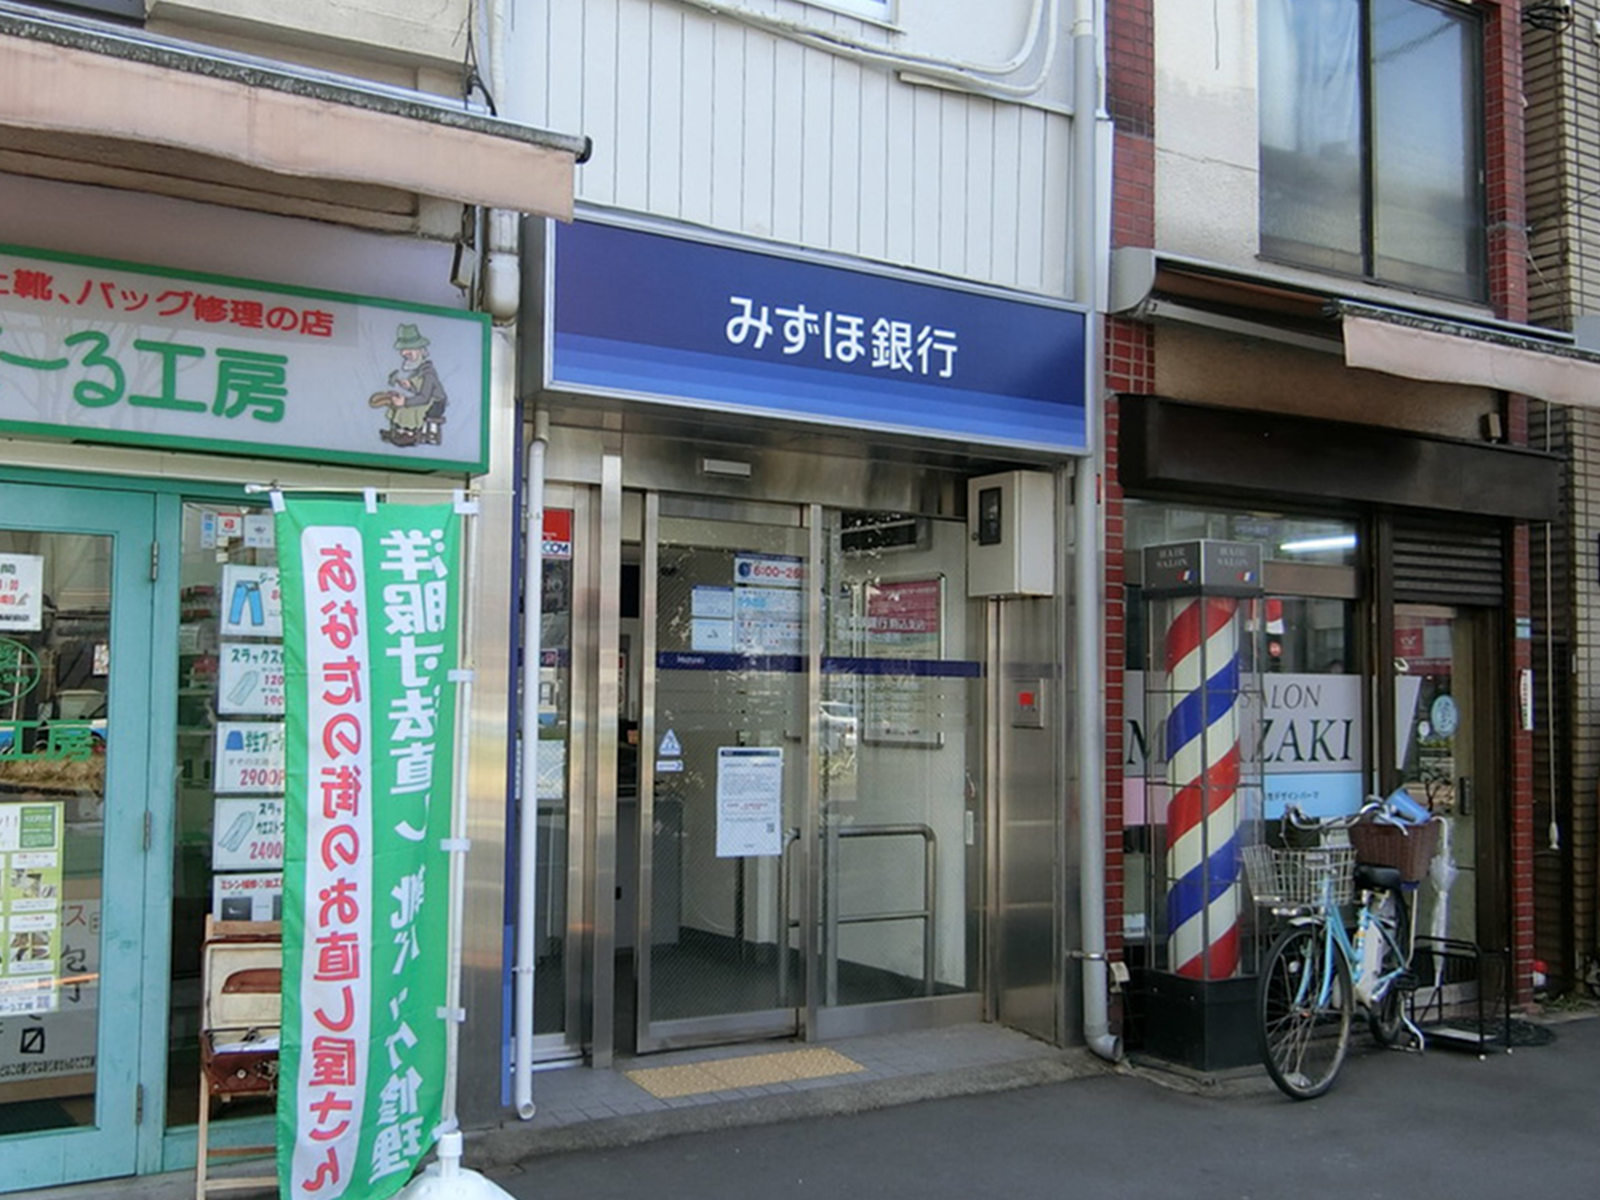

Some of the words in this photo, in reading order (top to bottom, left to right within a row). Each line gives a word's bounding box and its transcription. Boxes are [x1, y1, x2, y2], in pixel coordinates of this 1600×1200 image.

[725, 295, 959, 379] みずほ銀行
[1155, 558, 1189, 569] SALON
[1239, 682, 1322, 710] SALON
